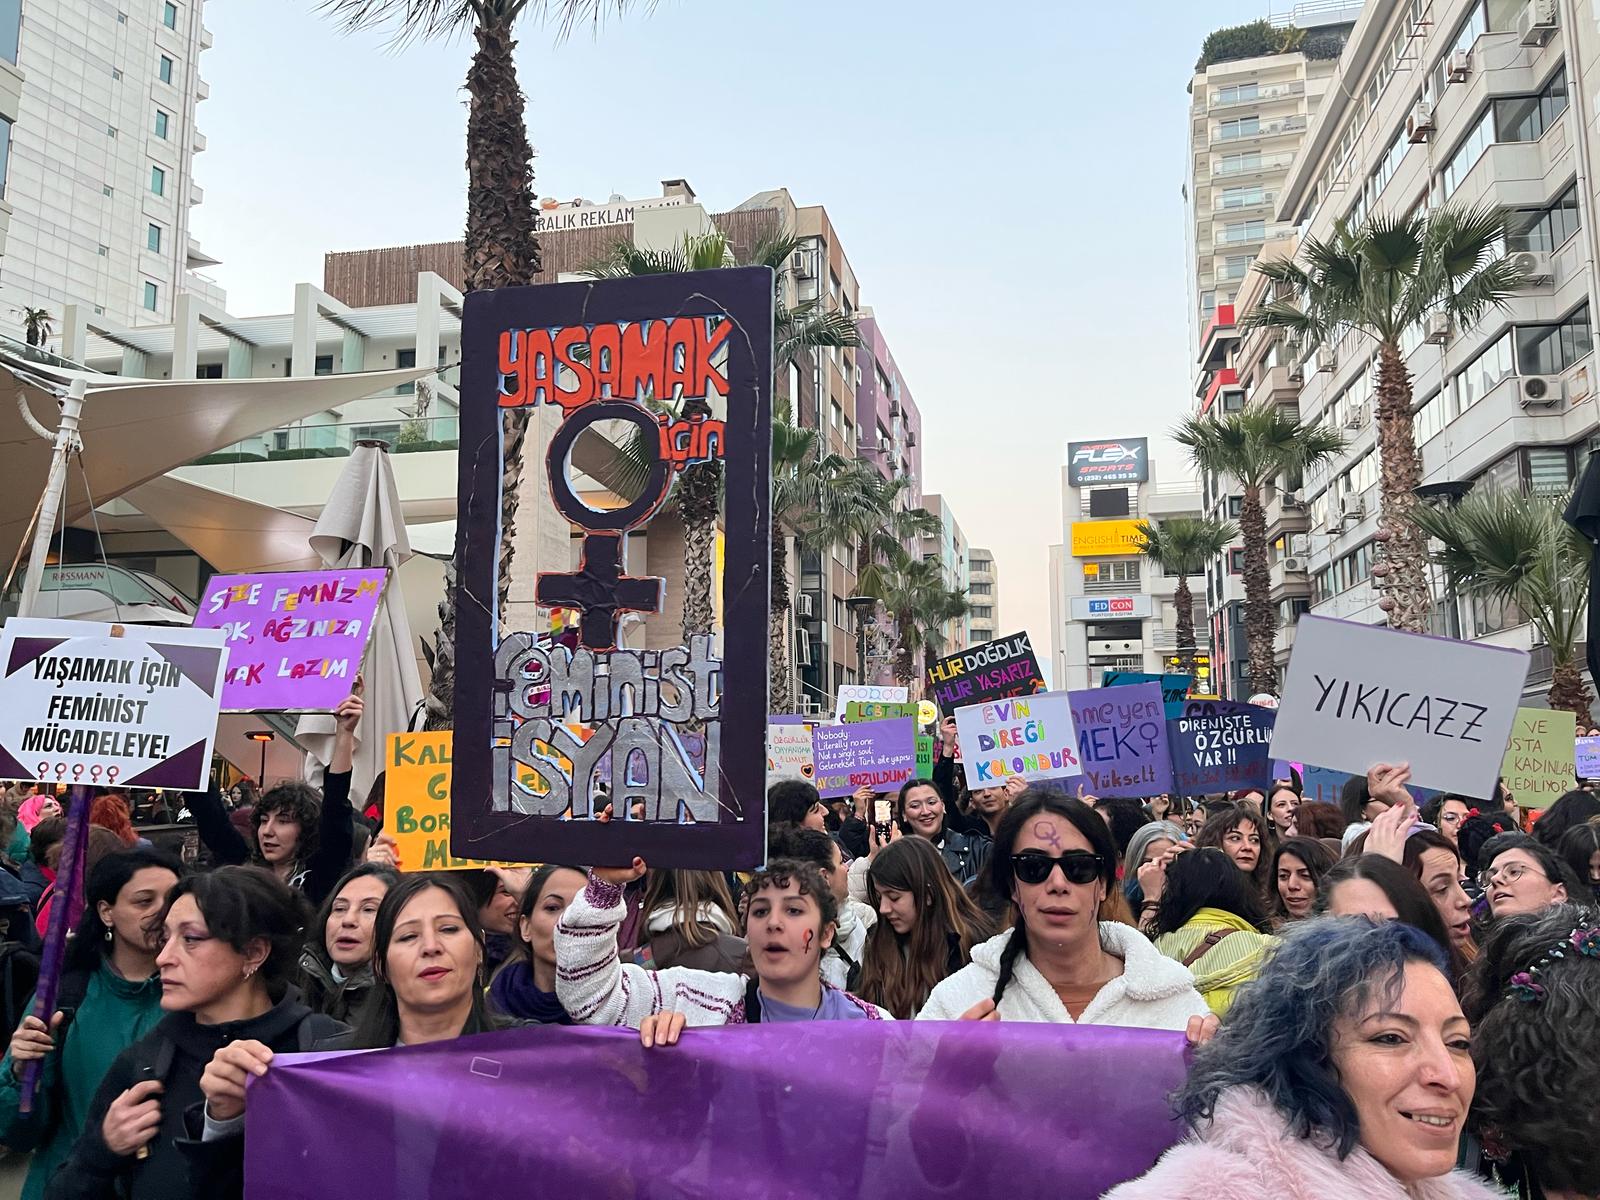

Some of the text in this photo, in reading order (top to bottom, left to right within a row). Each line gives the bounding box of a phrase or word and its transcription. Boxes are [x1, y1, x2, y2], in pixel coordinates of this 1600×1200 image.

[580, 206, 635, 227] REKLAM
[1072, 443, 1142, 465] FLEX
[1079, 463, 1135, 473] SPORTS
[1073, 534, 1144, 545] ENGLISH TIME
[209, 577, 378, 613] SİZE FEMİNİZM
[212, 616, 362, 644] OK, AĞZINIZA
[34, 656, 134, 688] YAŞAMAK
[224, 657, 349, 687] MAK LAZIM
[928, 636, 1032, 684] HÜR DOĞDUK
[936, 679, 974, 706] HÜR
[47, 692, 149, 725] FEMİNİST
[1313, 674, 1489, 743] YIKICAZZ
[977, 719, 1045, 752] DİREĞİ
[1195, 726, 1273, 751] ÖZGÜRLÜ
[1523, 720, 1548, 734] VE
[21, 723, 170, 760] MÜCADELEYE!
[817, 739, 849, 750] Literally
[818, 751, 831, 761] Not
[838, 749, 856, 761] single
[818, 757, 856, 771] Geleneksel
[860, 756, 876, 767] Türk
[976, 747, 1078, 781] KOLONDUR
[1193, 750, 1223, 767] VAR
[1514, 756, 1575, 777] KADINLAR
[849, 769, 907, 787] BOZULDUM
[1086, 764, 1156, 791] Yükselt
